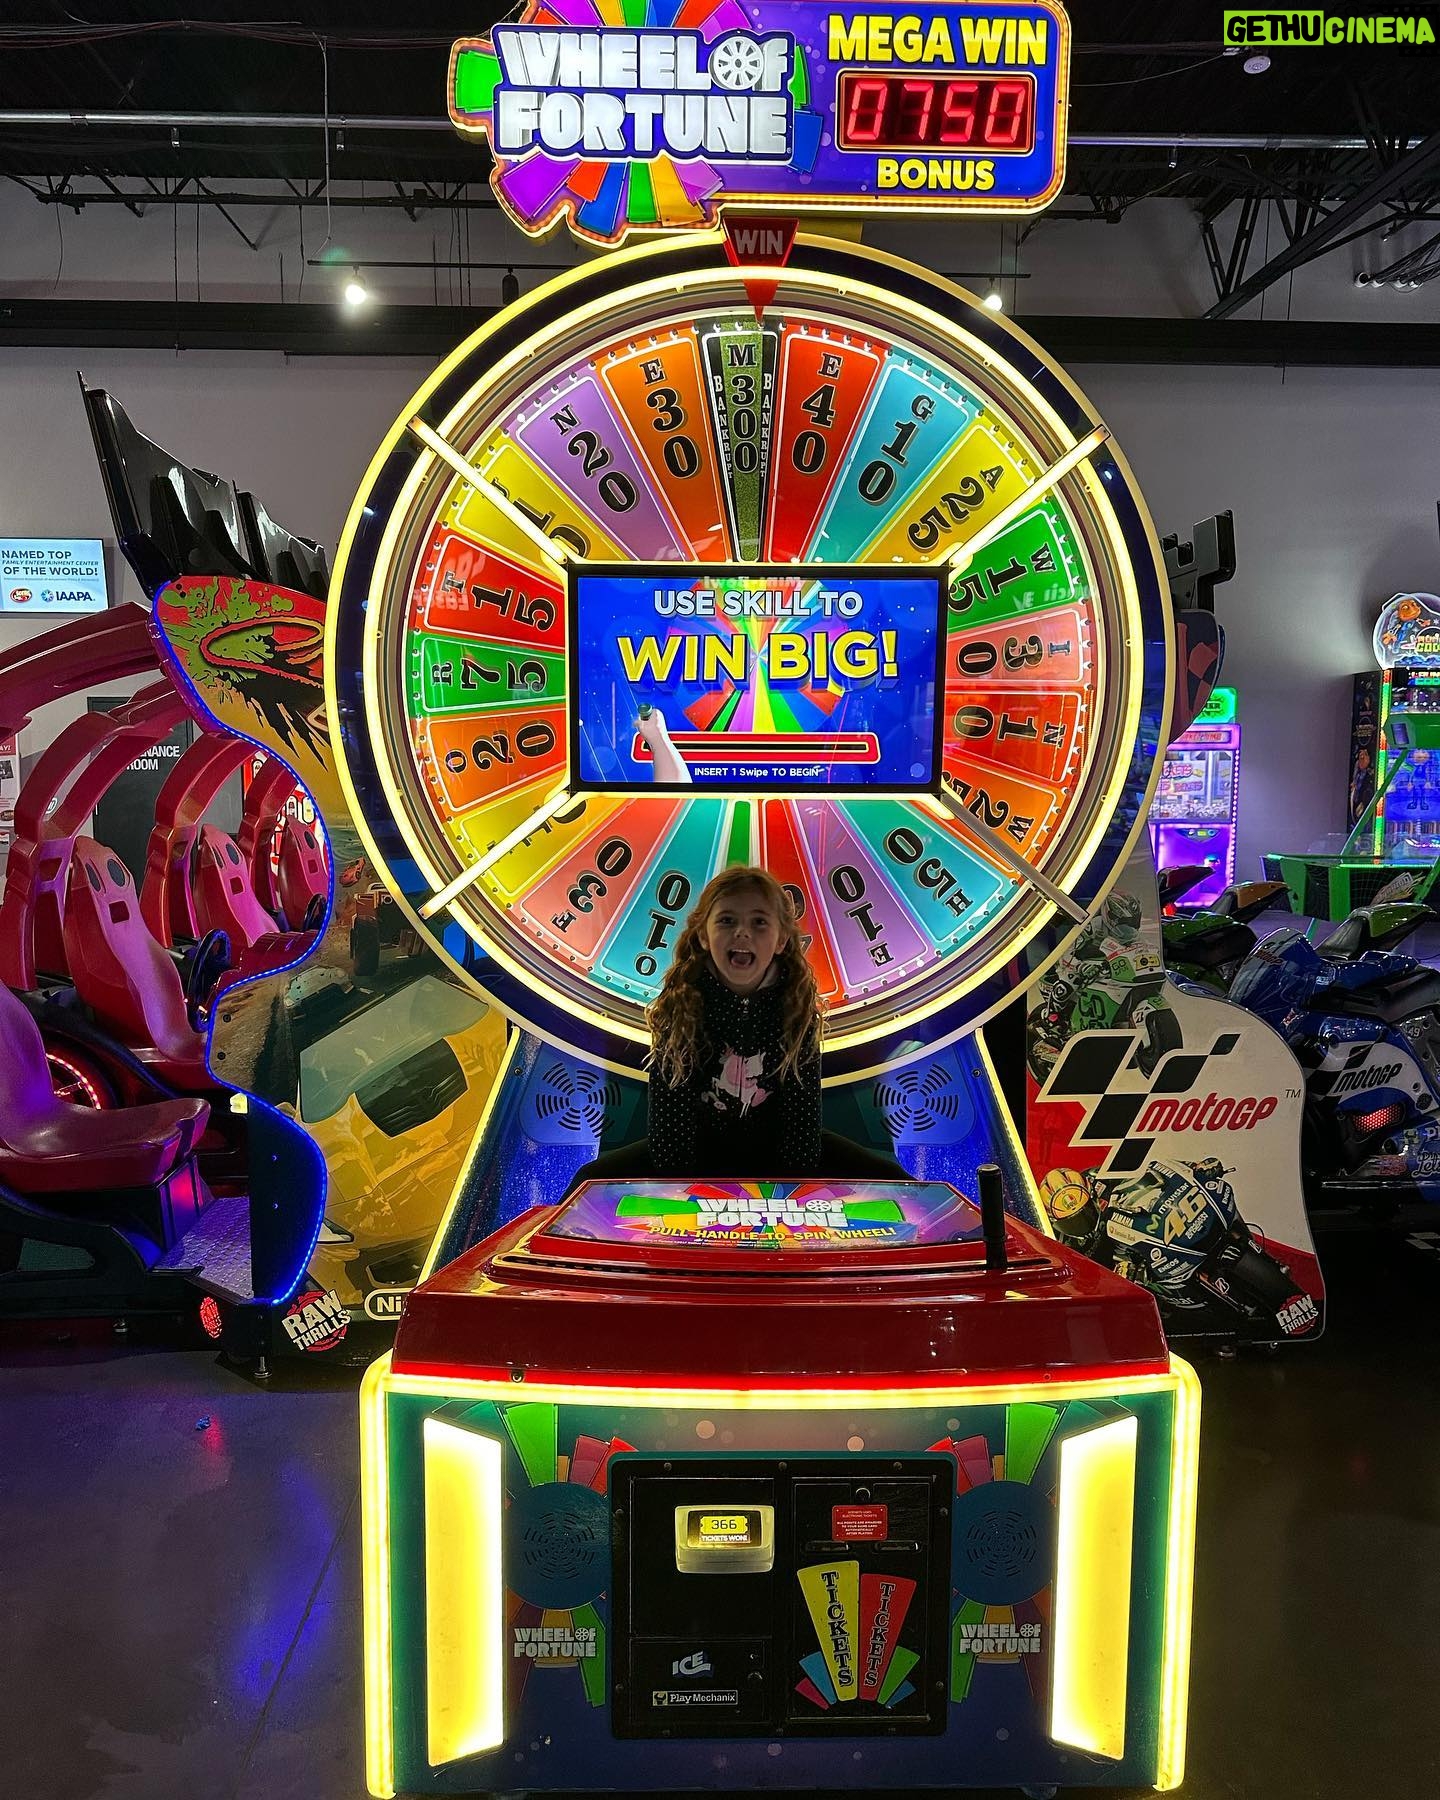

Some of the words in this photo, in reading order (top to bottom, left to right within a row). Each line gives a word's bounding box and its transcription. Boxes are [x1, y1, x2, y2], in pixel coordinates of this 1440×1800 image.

[828, 15, 968, 63] MEGA
[971, 19, 1047, 65] WIN
[498, 31, 711, 90] WHEEL
[499, 91, 787, 154] FORTUNE
[846, 82, 1026, 143] 0750
[877, 159, 996, 191] BONUS
[734, 228, 784, 256] WIN
[727, 344, 756, 367] M
[817, 353, 844, 379] E
[639, 358, 665, 386] E
[549, 404, 580, 436] N
[911, 395, 937, 421] G
[713, 375, 733, 479] BANKRUPT
[760, 373, 772, 478] BANKRUPT
[979, 465, 1006, 490] A
[2, 550, 45, 559] NAMED
[48, 551, 72, 559] TOP
[1030, 542, 1057, 573] W
[4, 567, 20, 575] OF
[23, 567, 47, 575] THE
[50, 568, 98, 576] WORLD!
[439, 571, 465, 595] T
[56, 591, 93, 602] IAAPA
[654, 590, 716, 616] USE
[723, 590, 811, 617] SKILL
[819, 591, 863, 616] TO
[617, 635, 747, 682] WIN
[768, 630, 898, 681] BIG!
[140, 745, 180, 757] NANCE
[694, 767, 729, 776] INSERT
[732, 768, 737, 776] 1
[739, 767, 769, 778] Swipe
[772, 768, 787, 776] TO
[789, 767, 819, 777] BEGIN
[1285, 1089, 1301, 1099] TM
[696, 1199, 806, 1212] WHEEL
[1158, 1182, 1190, 1215] movistar
[696, 1212, 848, 1227] FORTUNE
[1163, 1186, 1207, 1246] 46
[649, 1226, 689, 1237] PULL
[696, 1230, 760, 1240] HANDLE
[766, 1232, 786, 1240] TO
[794, 1231, 832, 1240] SPIN
[836, 1227, 897, 1239] WHEEL!
[1157, 1258, 1180, 1273] ENEOS
[281, 1289, 342, 1340] RAW
[1275, 1294, 1314, 1327] RAW
[1281, 1307, 1319, 1334] THRILLS
[292, 1310, 352, 1351] THRILLS
[711, 1519, 738, 1530] 366
[513, 1628, 574, 1642] WHEEL
[821, 1571, 855, 1688] TICKETS
[864, 1582, 897, 1687] TICKETS
[960, 1624, 1020, 1638] WHEEL
[513, 1642, 596, 1657] FORTUNE
[960, 1638, 1041, 1653] FORTUNE
[672, 1651, 711, 1675] ICE
[670, 1693, 692, 1704] Play
[692, 1693, 736, 1702] Mechanix
